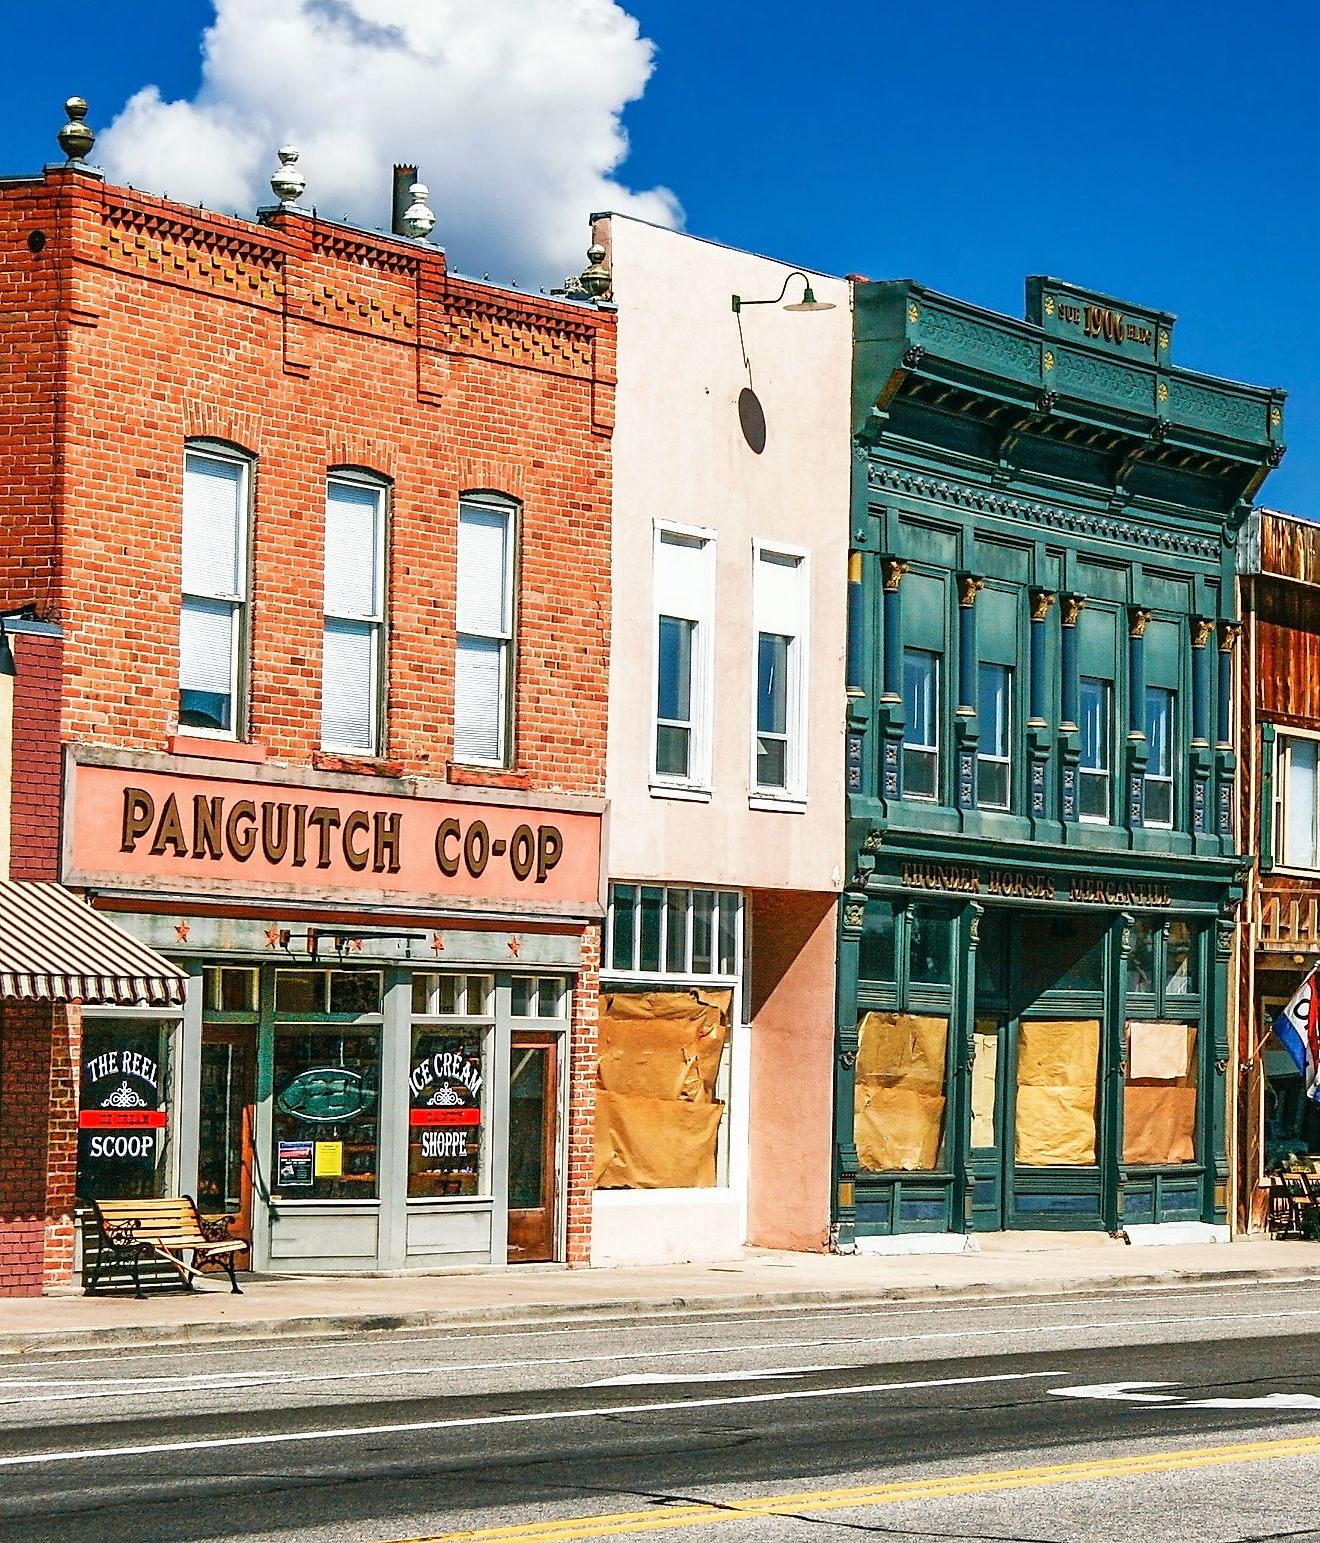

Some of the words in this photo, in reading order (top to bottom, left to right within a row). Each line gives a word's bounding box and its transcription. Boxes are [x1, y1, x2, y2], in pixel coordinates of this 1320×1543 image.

[119, 787, 402, 873] PANGUITCH
[435, 818, 563, 884] CO-OP
[901, 863, 980, 893] THUNDER
[987, 871, 1055, 899] HORSES
[1068, 878, 1172, 908] MERCANTILE
[88, 1051, 118, 1082] THE
[122, 1050, 157, 1088] REEL
[409, 1059, 433, 1098] ICE
[433, 1052, 483, 1098] CREAM
[90, 1136, 153, 1157] SCOOP
[421, 1131, 468, 1157] SHOPPE
